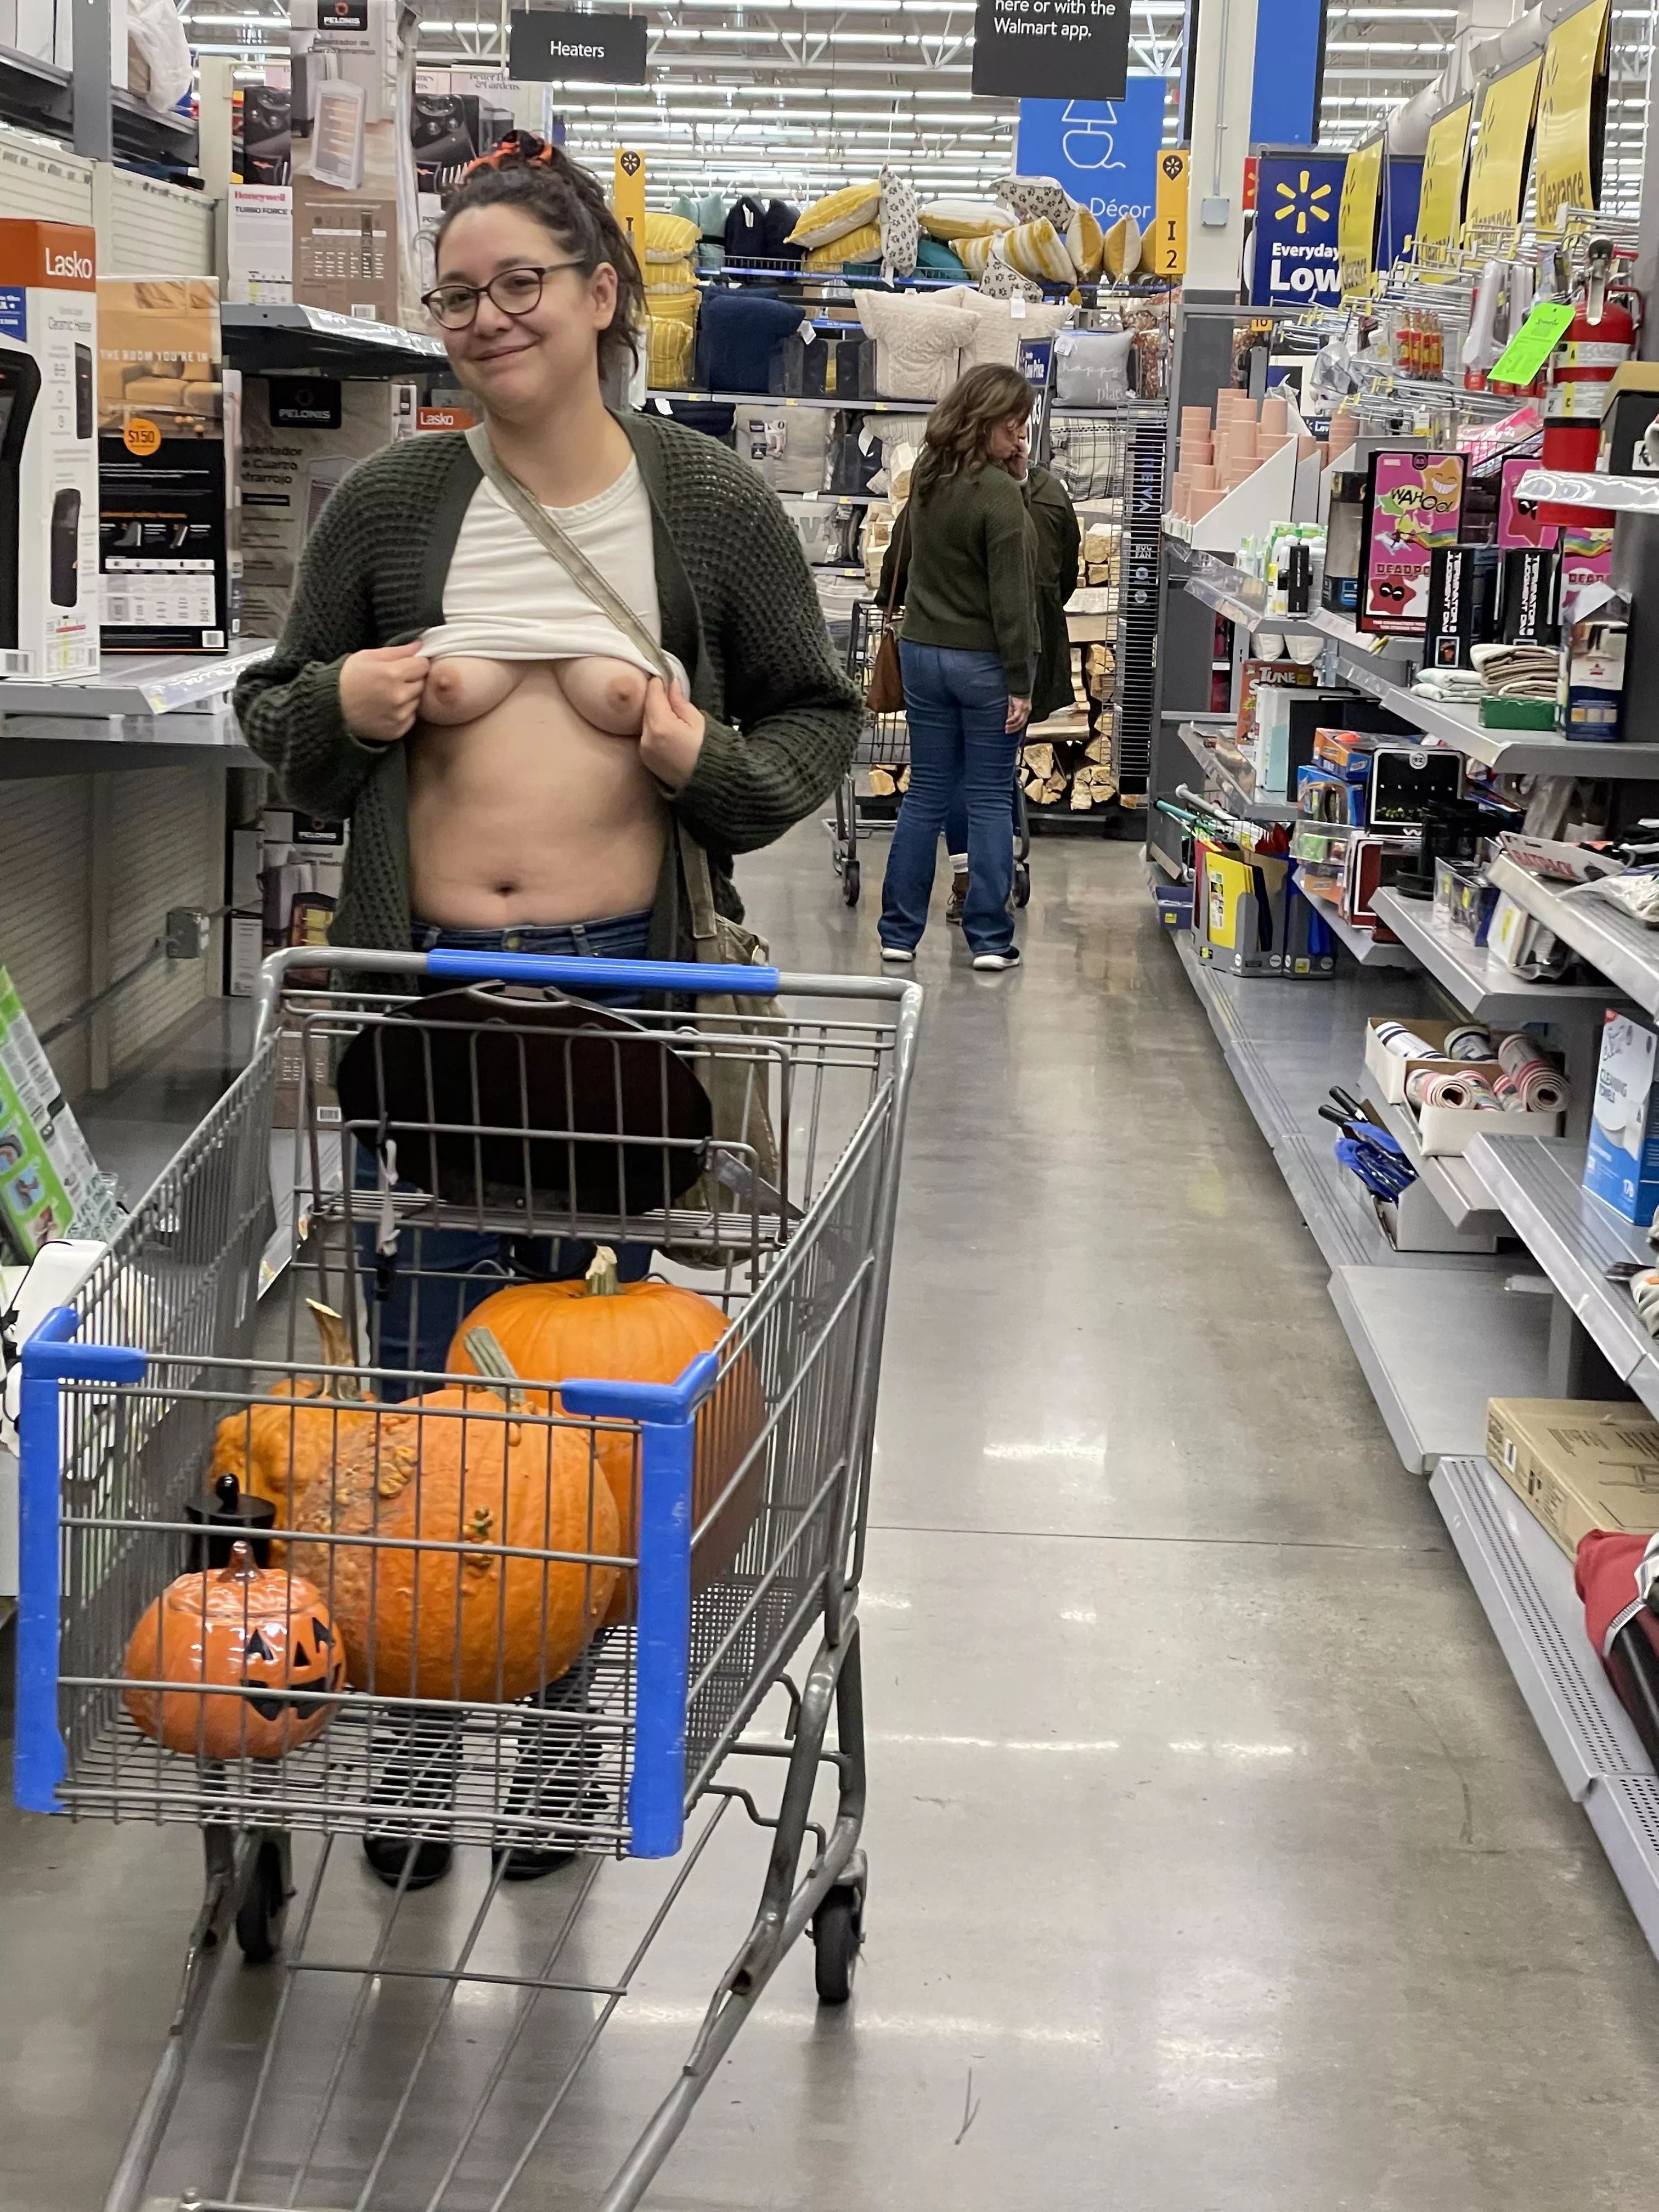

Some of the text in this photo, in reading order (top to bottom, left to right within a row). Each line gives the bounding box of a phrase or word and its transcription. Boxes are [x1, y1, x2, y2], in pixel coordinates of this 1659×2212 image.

[995, 0, 1116, 15] here or with the
[994, 17, 1092, 41] Walmart app.
[550, 41, 605, 58] Heaters
[234, 190, 286, 202] Honeywell
[1539, 170, 1585, 226] Clearance
[1090, 198, 1151, 218] Décor
[1272, 242, 1339, 261] Everyday
[45, 247, 92, 279] Lasko
[1269, 259, 1342, 292] Low
[122, 349, 154, 361] ROOM
[1062, 362, 1122, 377] happy
[279, 409, 330, 419] PELONIS
[420, 412, 454, 426] Lasko
[128, 430, 155, 443] $150
[1391, 488, 1453, 514] WAHOO!
[1376, 564, 1430, 575] DEADPO
[1259, 666, 1296, 684] TUNE
